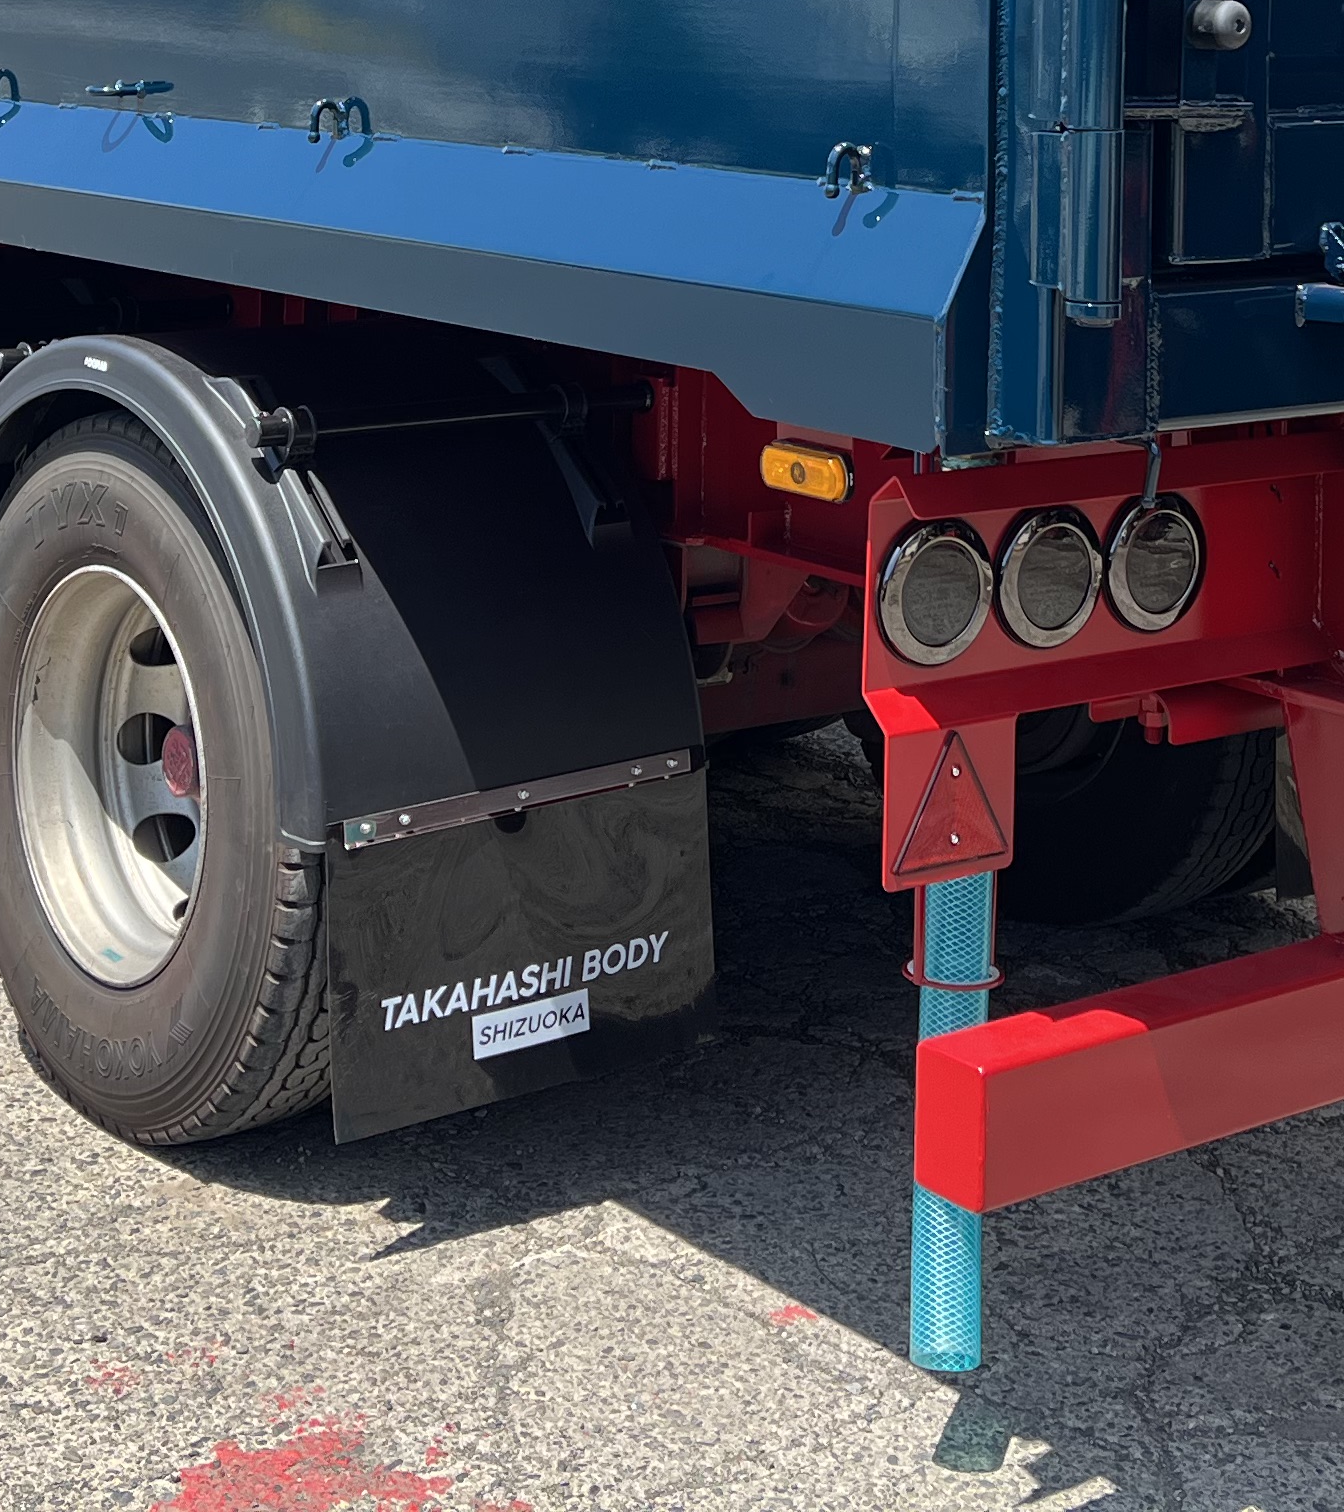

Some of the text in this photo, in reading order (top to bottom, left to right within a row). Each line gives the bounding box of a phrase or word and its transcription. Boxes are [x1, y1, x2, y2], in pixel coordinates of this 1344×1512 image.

[381, 930, 669, 1032] TAKAHASHI BODY
[478, 1002, 586, 1046] SHIZUOKA
